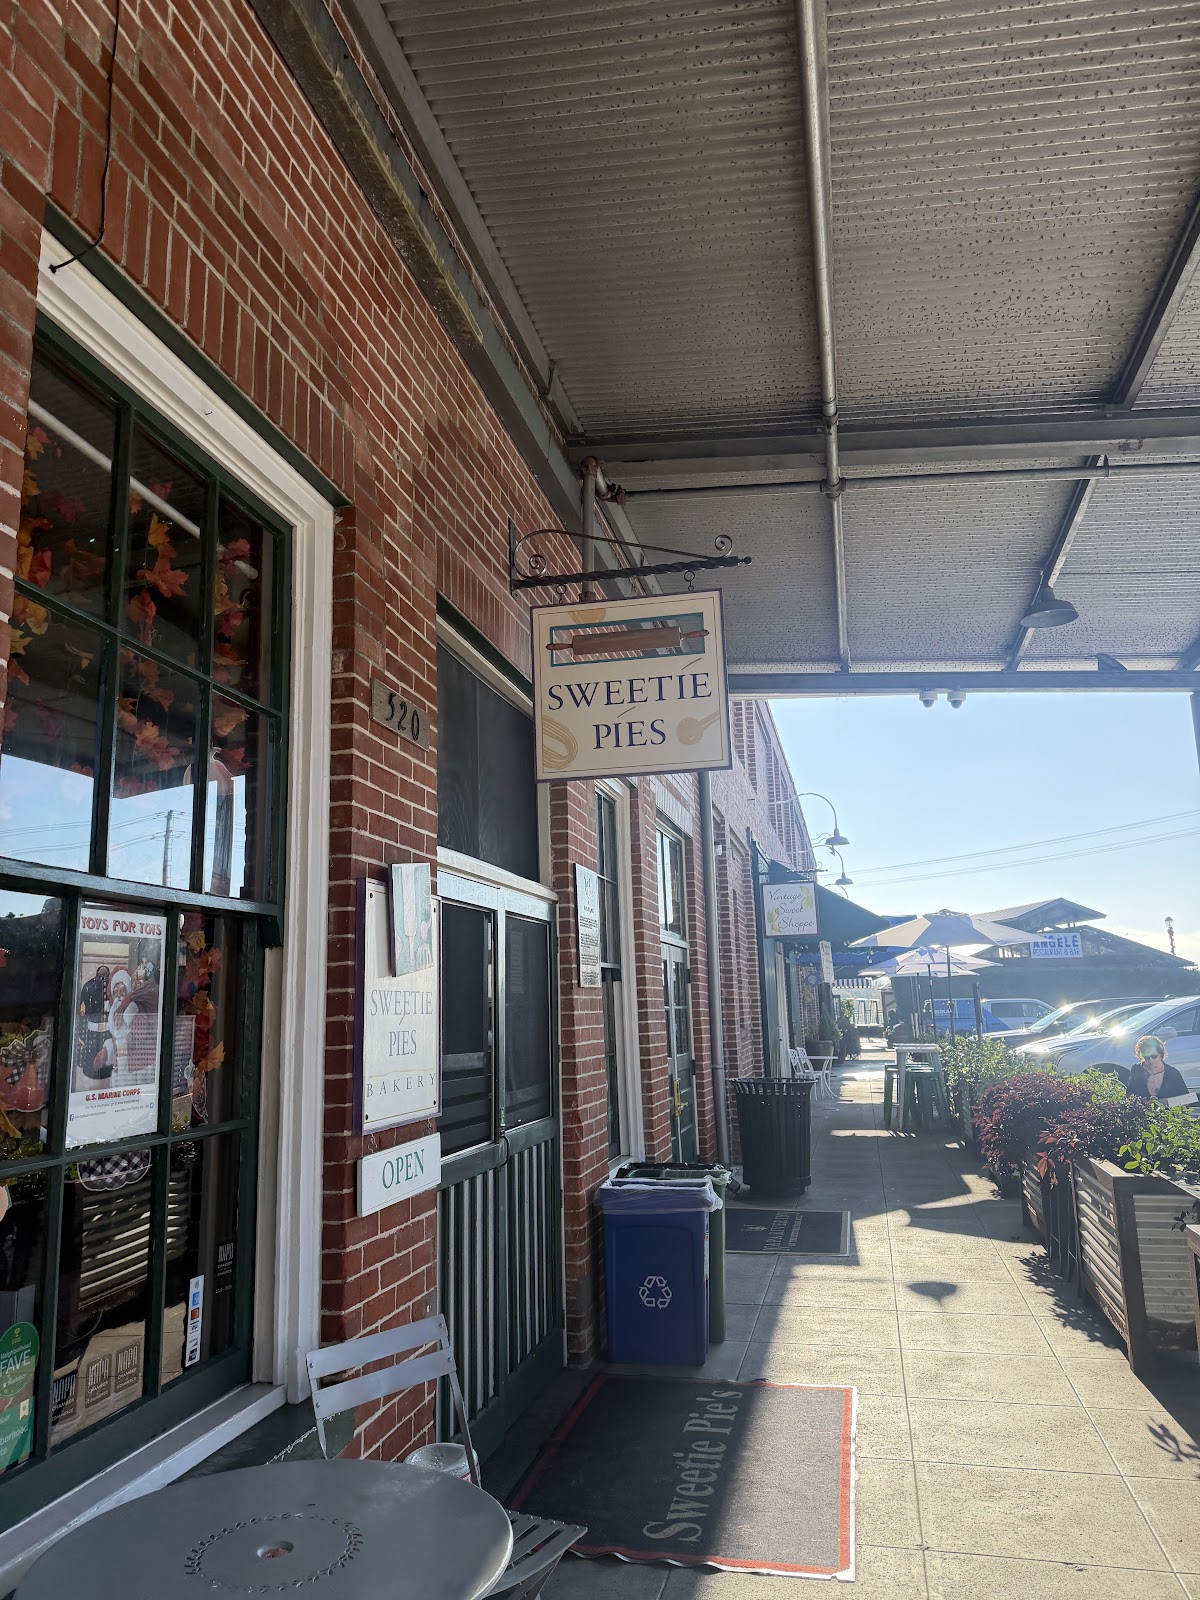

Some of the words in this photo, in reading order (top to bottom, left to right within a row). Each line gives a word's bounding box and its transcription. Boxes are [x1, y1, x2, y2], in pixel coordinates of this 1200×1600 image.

[548, 672, 712, 711] SWEETIE
[384, 692, 420, 741] 520
[592, 718, 667, 750] PIES
[768, 888, 804, 904] Vintage
[775, 902, 805, 915] Sweet
[80, 916, 109, 931] TOYS
[112, 919, 136, 934] FOR
[139, 922, 162, 935] TOTS
[777, 916, 815, 931] Shoppe
[370, 988, 434, 1016] SWEETIE
[389, 1029, 417, 1057] PIES
[85, 1093, 97, 1101] U.S.
[98, 1090, 121, 1100] MARINE
[122, 1088, 141, 1097] CORPS
[366, 1072, 436, 1098] BAKERY
[382, 1148, 425, 1189] OPEN
[0, 1348, 32, 1378] FAVE
[117, 1345, 138, 1373] NAPA
[52, 1374, 76, 1404] NAPA
[683, 1390, 743, 1436] Pie's
[643, 1440, 727, 1544] Sweetie
